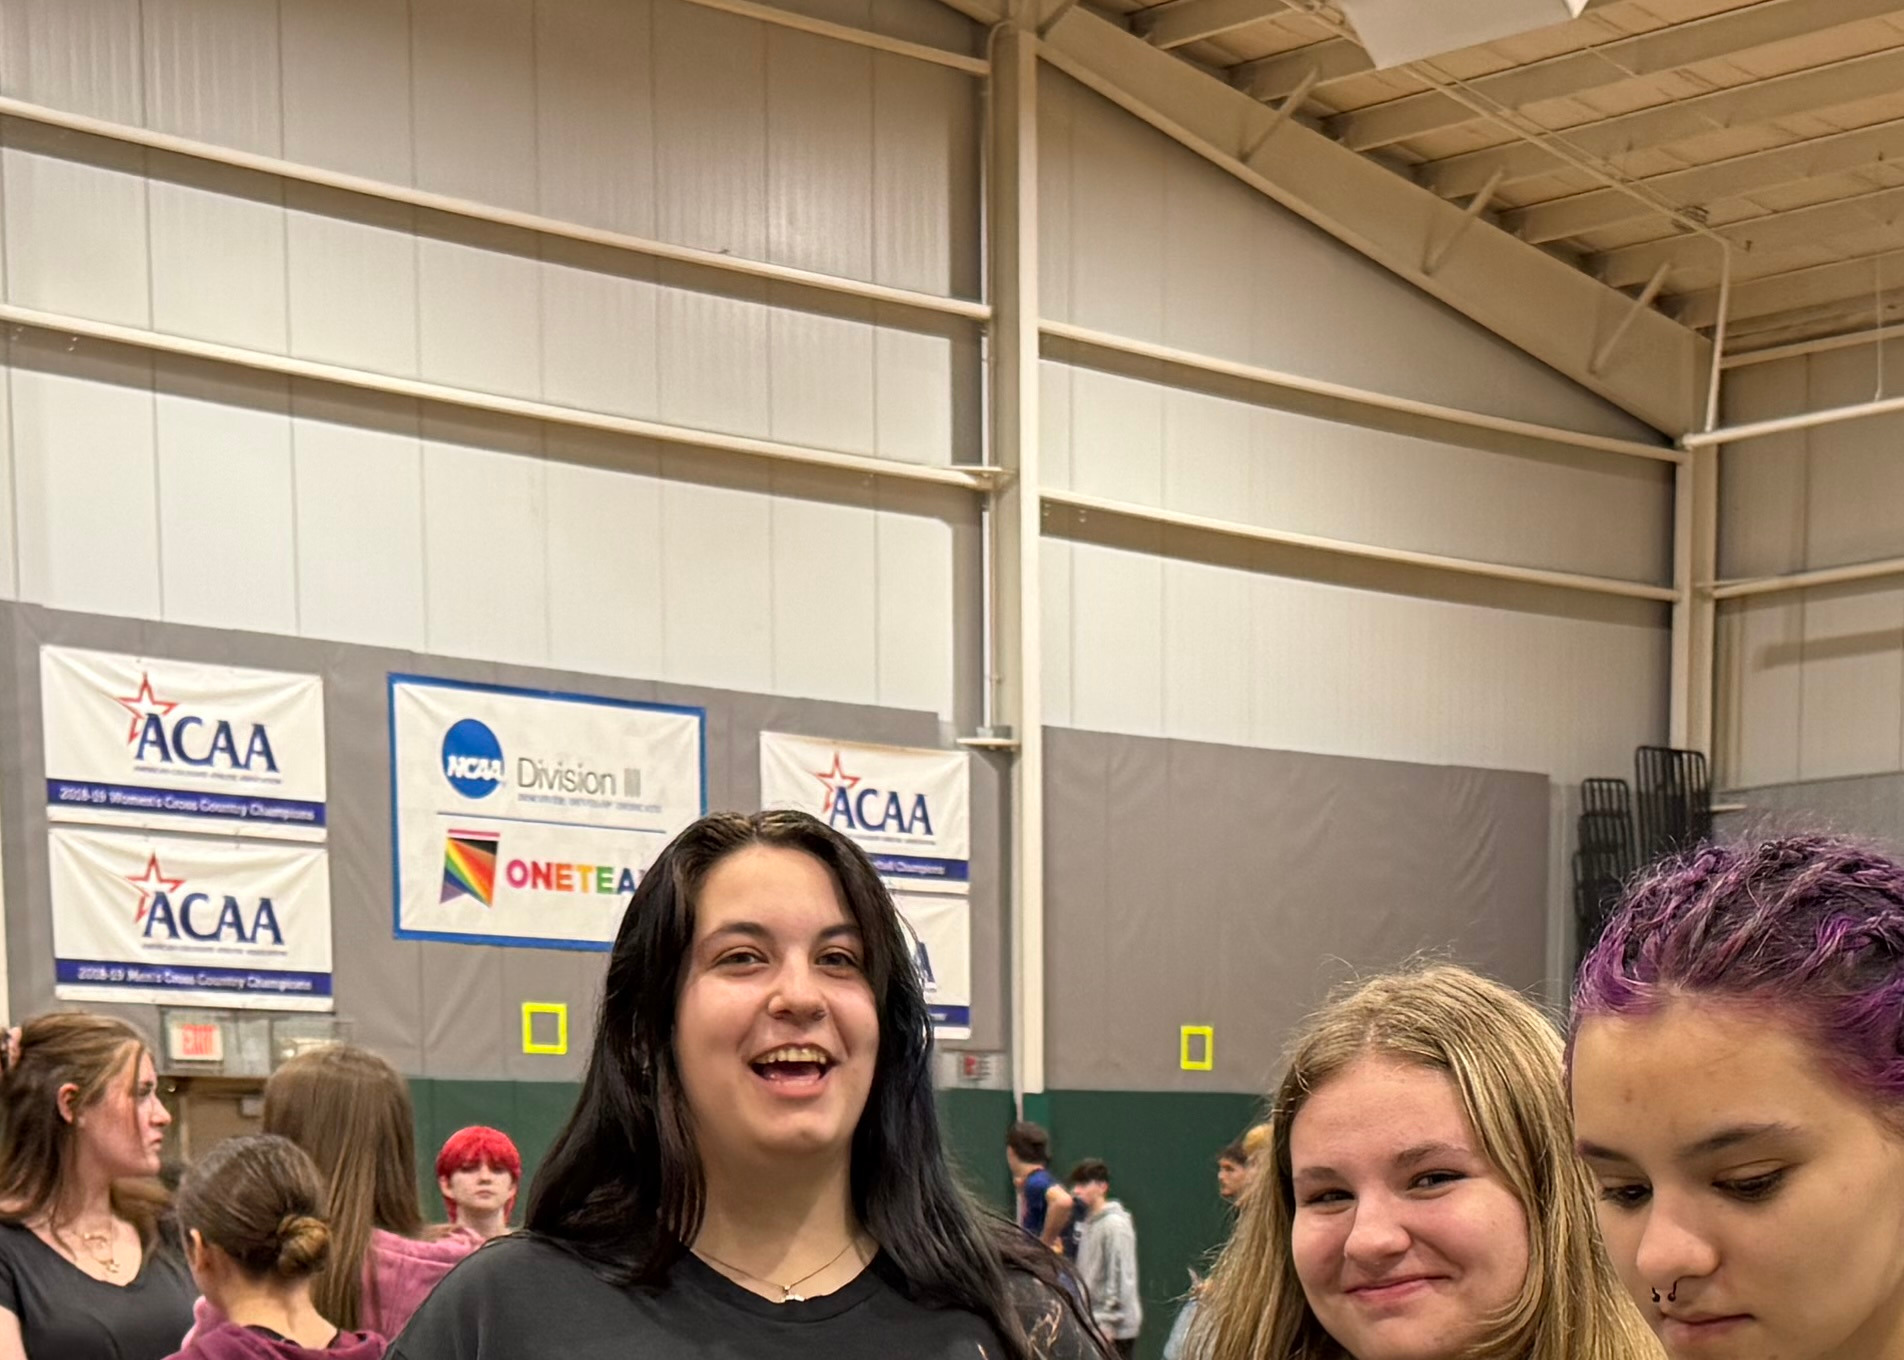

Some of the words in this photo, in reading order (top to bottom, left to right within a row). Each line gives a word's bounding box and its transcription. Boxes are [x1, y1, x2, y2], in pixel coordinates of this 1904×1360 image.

[134, 713, 280, 773] ACAA
[447, 755, 504, 781] NCAA
[517, 757, 616, 796] Division
[829, 785, 933, 836] ACAA
[506, 859, 643, 896] ONETEA
[142, 891, 285, 946] ACAA
